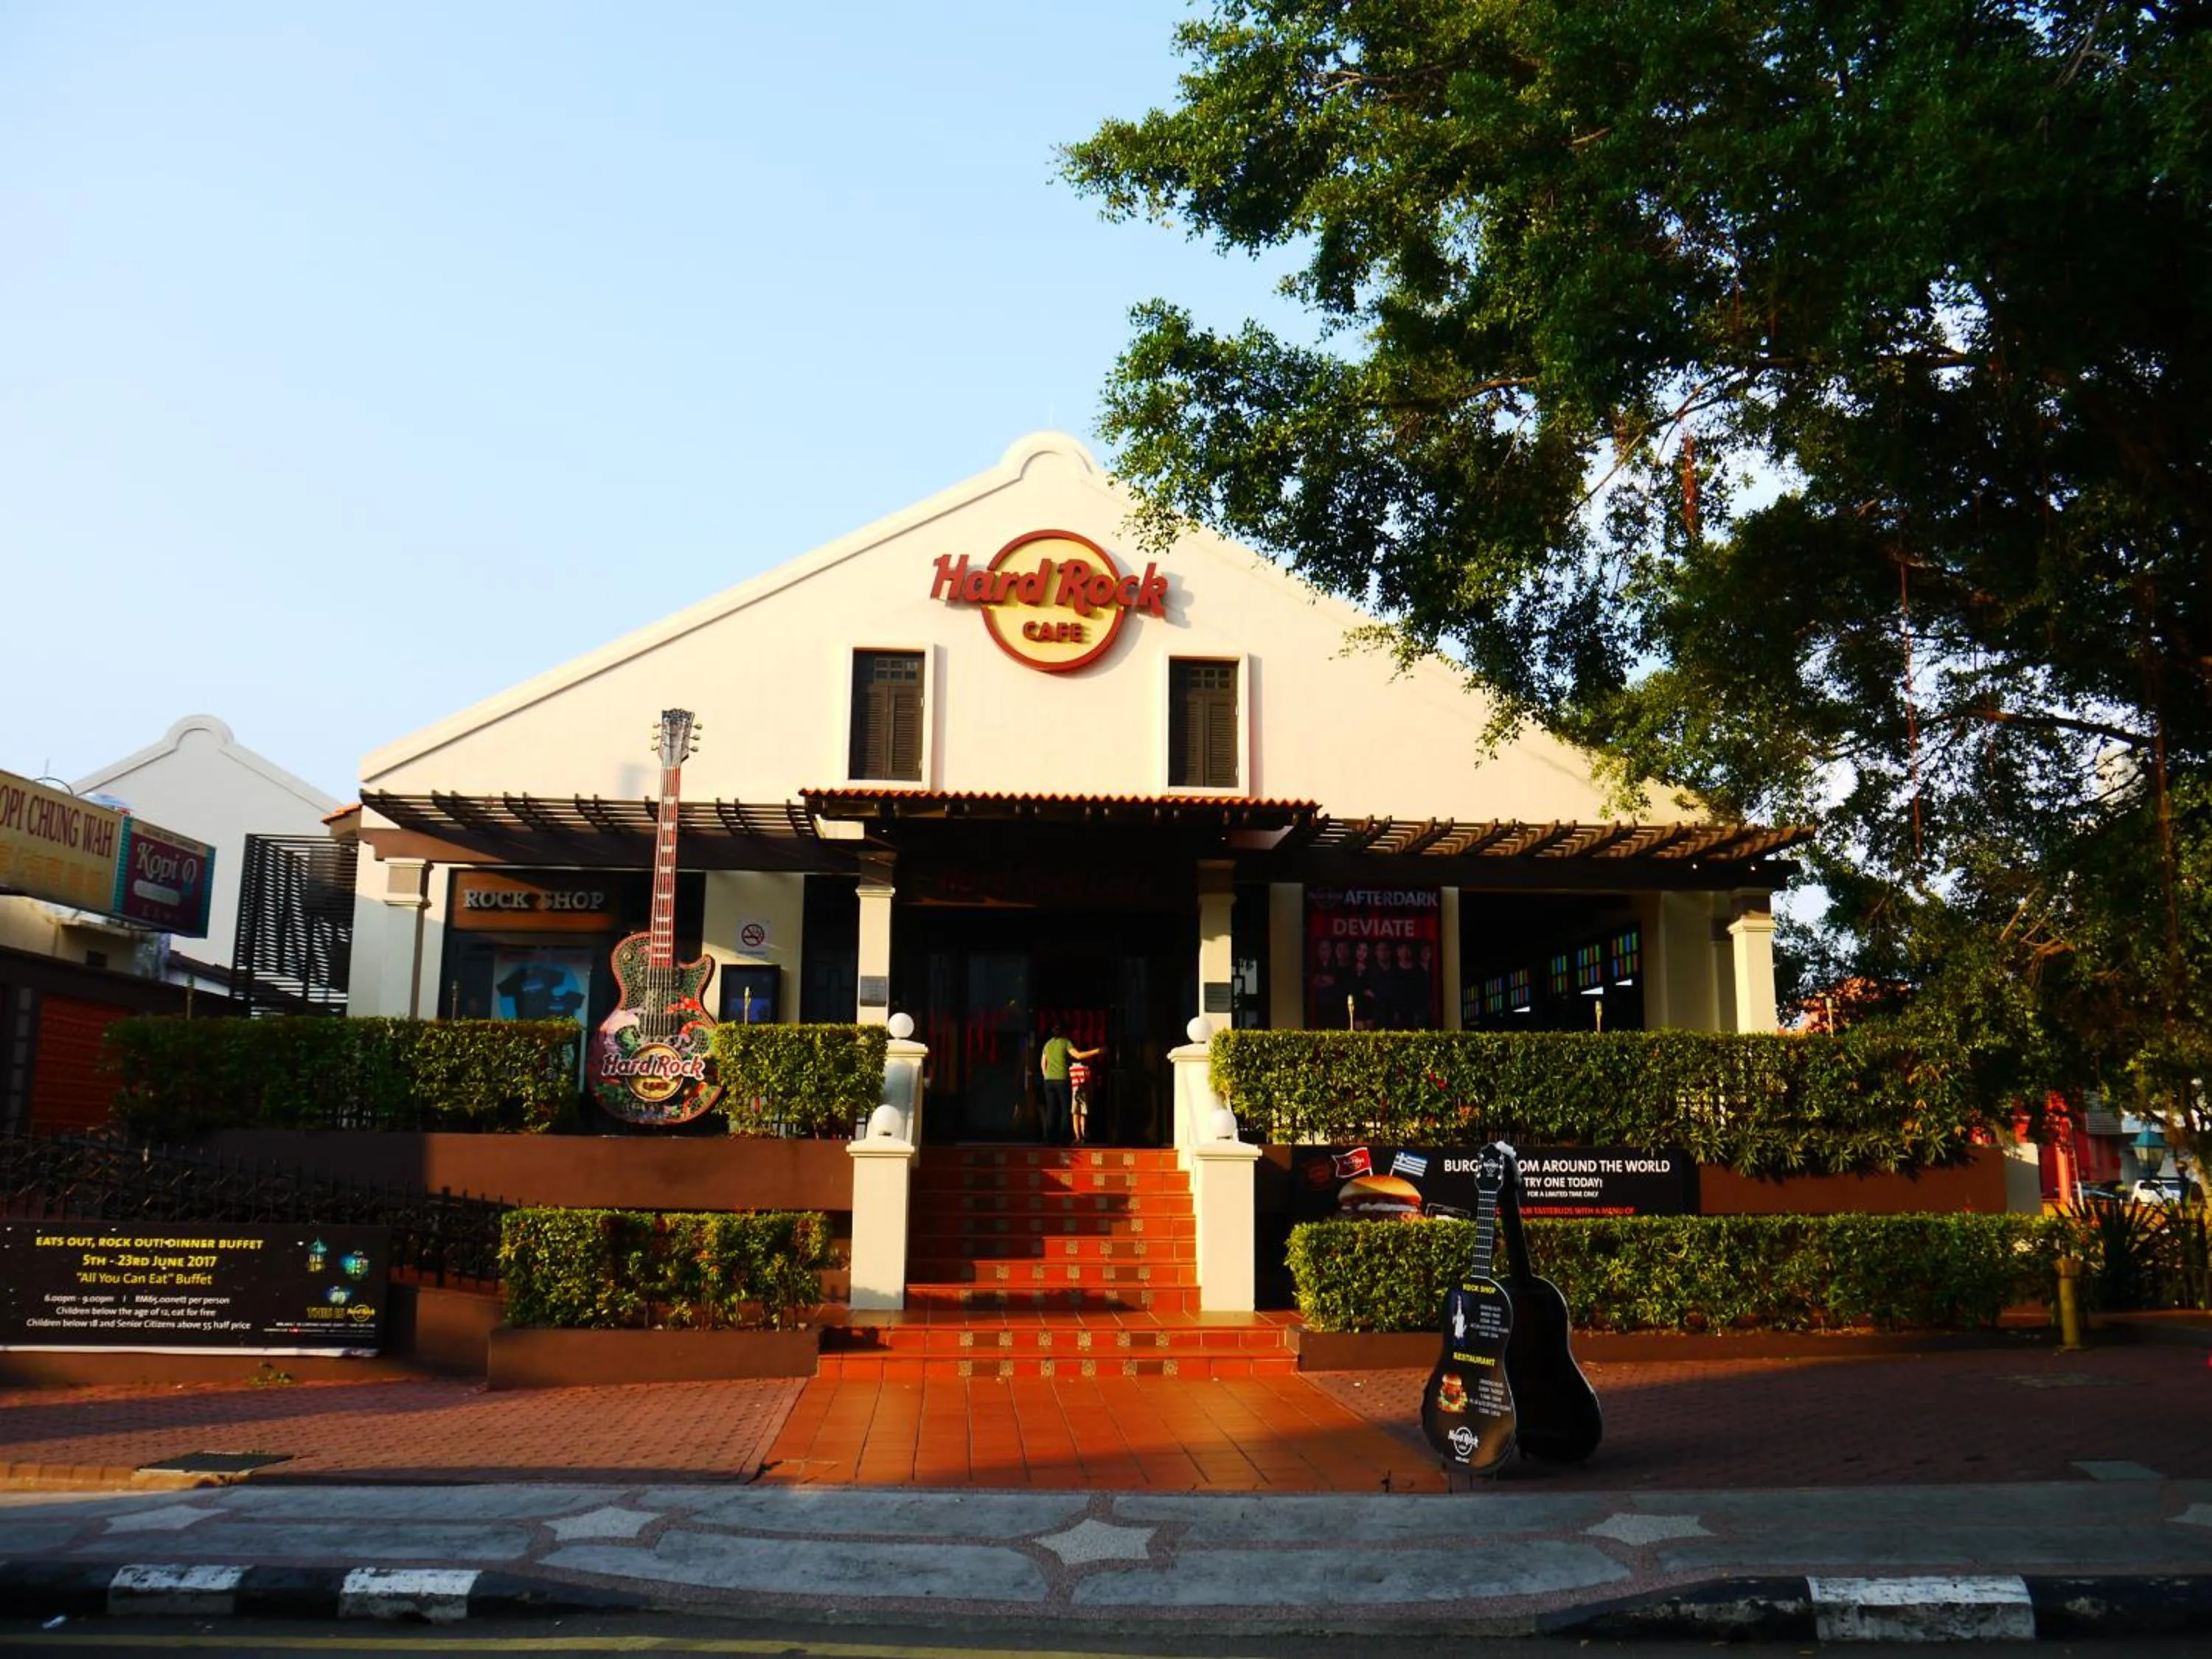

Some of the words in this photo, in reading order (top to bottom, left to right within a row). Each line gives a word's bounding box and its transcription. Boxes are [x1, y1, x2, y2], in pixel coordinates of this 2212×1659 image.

[931, 554, 1052, 605] Hard
[1054, 559, 1169, 618] Rock
[1022, 622, 1084, 642] CAFE
[28, 795, 80, 848] CHUNG
[83, 813, 115, 858] WAH
[136, 841, 178, 883] Kopi
[464, 889, 529, 909] ROCK
[538, 891, 605, 911] SHOP
[1344, 889, 1439, 908] AFTERDARK
[1332, 918, 1416, 937] DEVIATE
[601, 1052, 655, 1077] Hard
[656, 1053, 706, 1081] Rock
[1444, 1158, 1478, 1172] BURG
[1517, 1159, 1540, 1172] OM
[1542, 1160, 1597, 1173] AROUND
[1599, 1160, 1623, 1173] THE
[1625, 1160, 1671, 1173] WORLD
[1523, 1177, 1542, 1188] TRY
[1543, 1177, 1565, 1188] ONE
[1567, 1177, 1603, 1189] TODAY!
[35, 1237, 64, 1247] EATS
[67, 1237, 95, 1248] OUT,
[98, 1237, 131, 1248] ROCK
[166, 1238, 215, 1248] DINNER
[218, 1239, 264, 1249] BUFFET
[82, 1254, 106, 1267] 5TH
[117, 1254, 150, 1267] 23RD
[187, 1256, 218, 1267] 2017
[99, 1273, 120, 1284] You
[123, 1273, 146, 1284] Can
[175, 1273, 213, 1285] Buffet
[188, 1297, 203, 1305] per
[204, 1297, 230, 1305] person
[55, 1306, 90, 1315] Children
[91, 1307, 117, 1315] below
[119, 1307, 133, 1315] the
[133, 1309, 149, 1318] age
[150, 1307, 159, 1316] of
[186, 1307, 198, 1316] for
[200, 1308, 217, 1316] free
[27, 1318, 61, 1326] Children
[62, 1318, 88, 1327] below
[99, 1319, 116, 1327] and
[116, 1319, 142, 1328] Senior
[144, 1320, 175, 1329] Citizens
[177, 1320, 201, 1329] above
[214, 1321, 230, 1329] half
[231, 1321, 251, 1331] price
[1453, 1352, 1495, 1366] RESTAURANT
